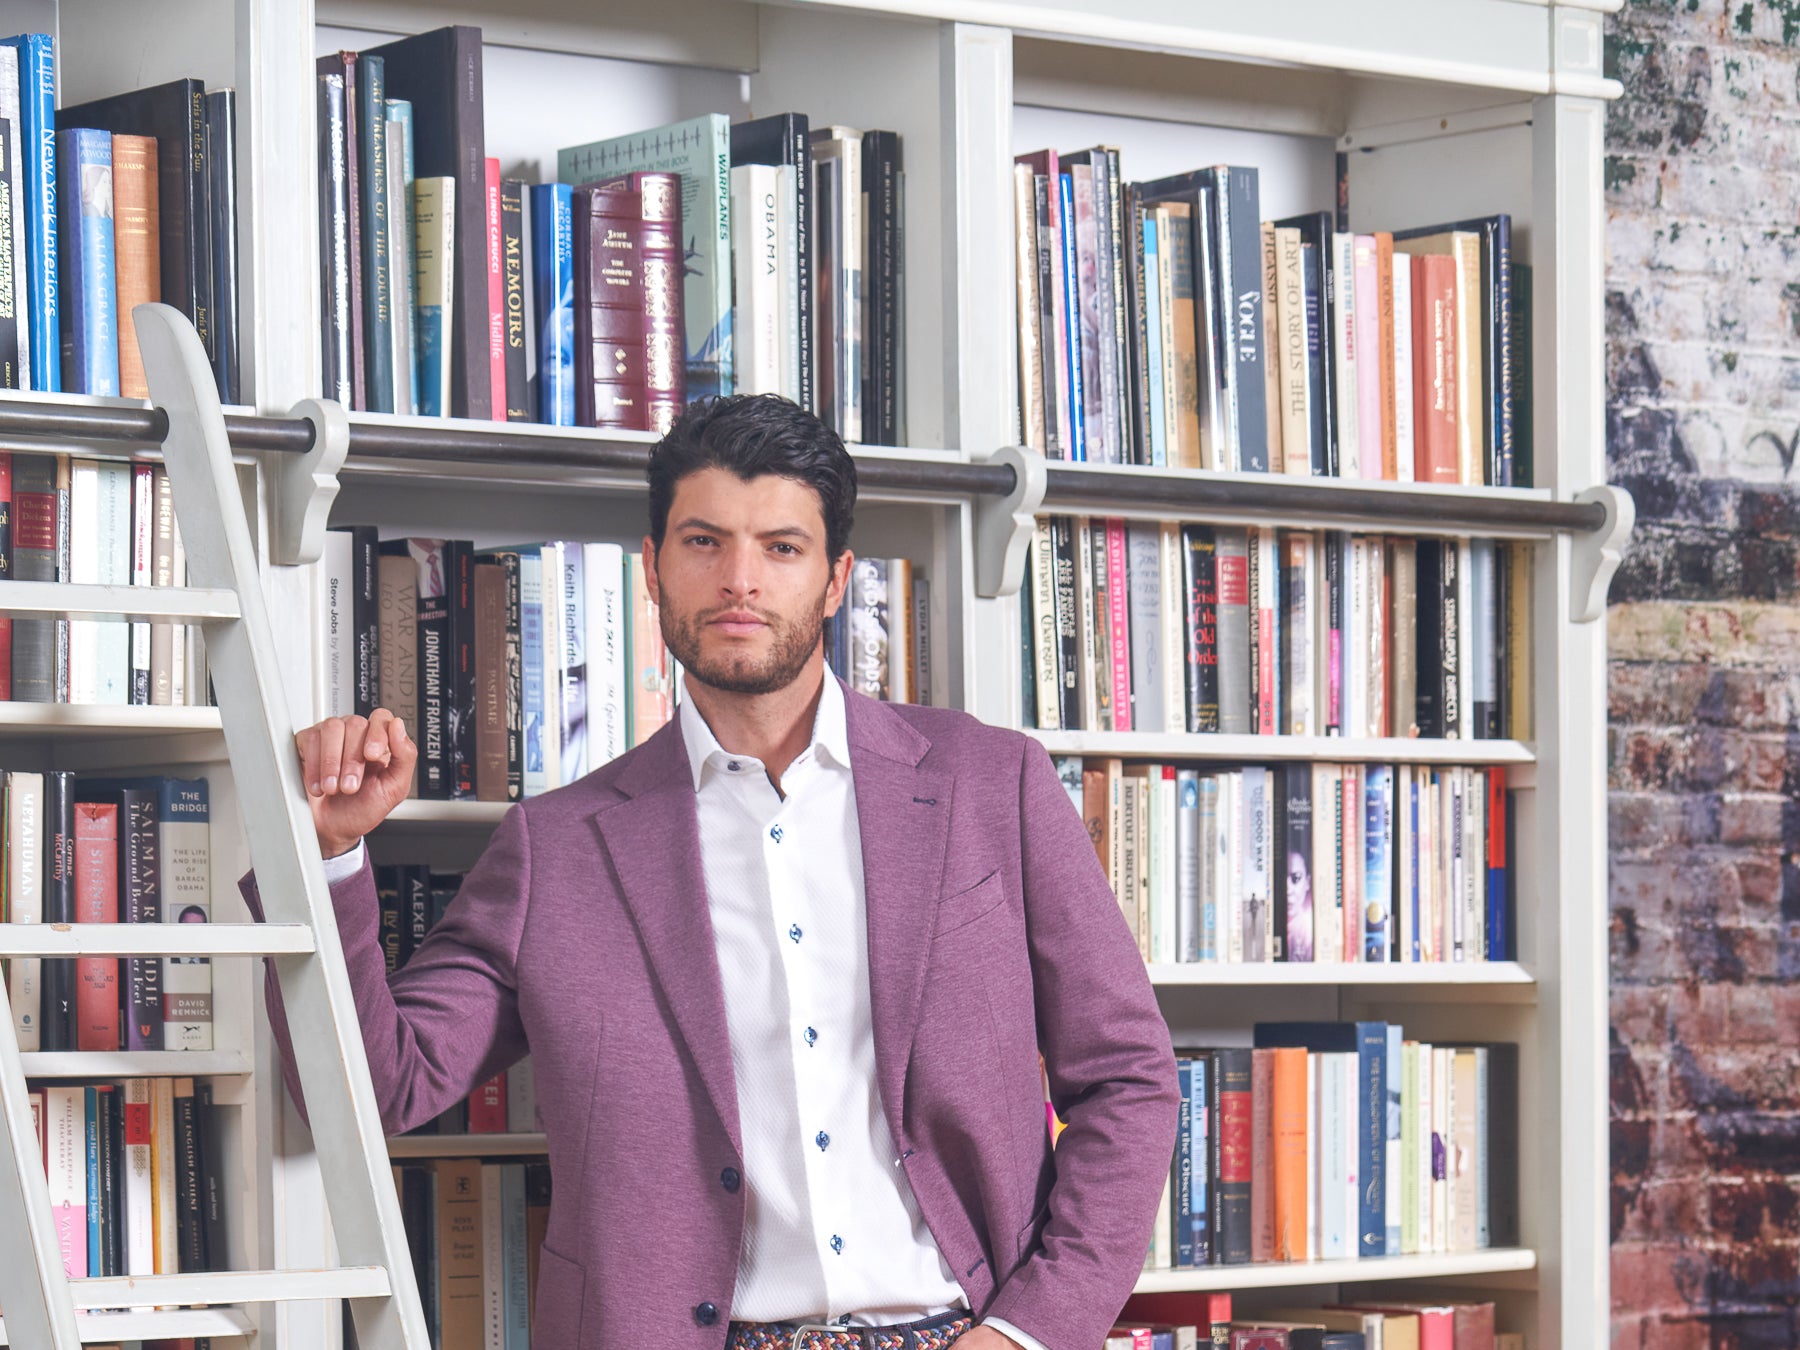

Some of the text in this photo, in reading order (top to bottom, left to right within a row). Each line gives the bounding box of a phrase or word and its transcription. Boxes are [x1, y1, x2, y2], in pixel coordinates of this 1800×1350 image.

[192, 92, 202, 150] Saris in the
[42, 129, 57, 317] New York Interiors
[370, 77, 387, 324] ART TREASURES OF THE LOUVRE
[717, 153, 729, 241] WARPLANES
[563, 207, 572, 258] CORMAC
[764, 193, 777, 276] OBAMA
[490, 187, 504, 360] ELINOR CARUCCI Midlife
[505, 235, 522, 348] MEMOIRS
[1264, 231, 1277, 304] PICASSO
[1239, 291, 1261, 362] VOGUE
[1287, 236, 1306, 416] THE STORY OF ART
[330, 578, 339, 686] Steve Jobs by Walter
[565, 564, 576, 663] Keith Richards
[1112, 577, 1122, 622] SMITH
[359, 632, 371, 702] videotape
[396, 584, 415, 697] WAR AND
[1115, 639, 1124, 659] ON
[1194, 629, 1214, 645] Old
[424, 629, 441, 760] JONATHAN FRANZEN
[1116, 664, 1126, 718] BEAUTY
[130, 802, 140, 827] The
[171, 803, 207, 812] BRIDGE
[181, 792, 199, 801] THE
[21, 793, 34, 897] METAHUMAN
[53, 833, 64, 881] McCarthy
[131, 833, 141, 883] Ground
[142, 802, 155, 895] SALMAN
[412, 879, 426, 942] ALEXEI
[172, 1008, 210, 1016] REMNICK
[1181, 1097, 1191, 1128] Jude
[1181, 1132, 1191, 1155] the
[185, 1124, 194, 1168] ENGLISH
